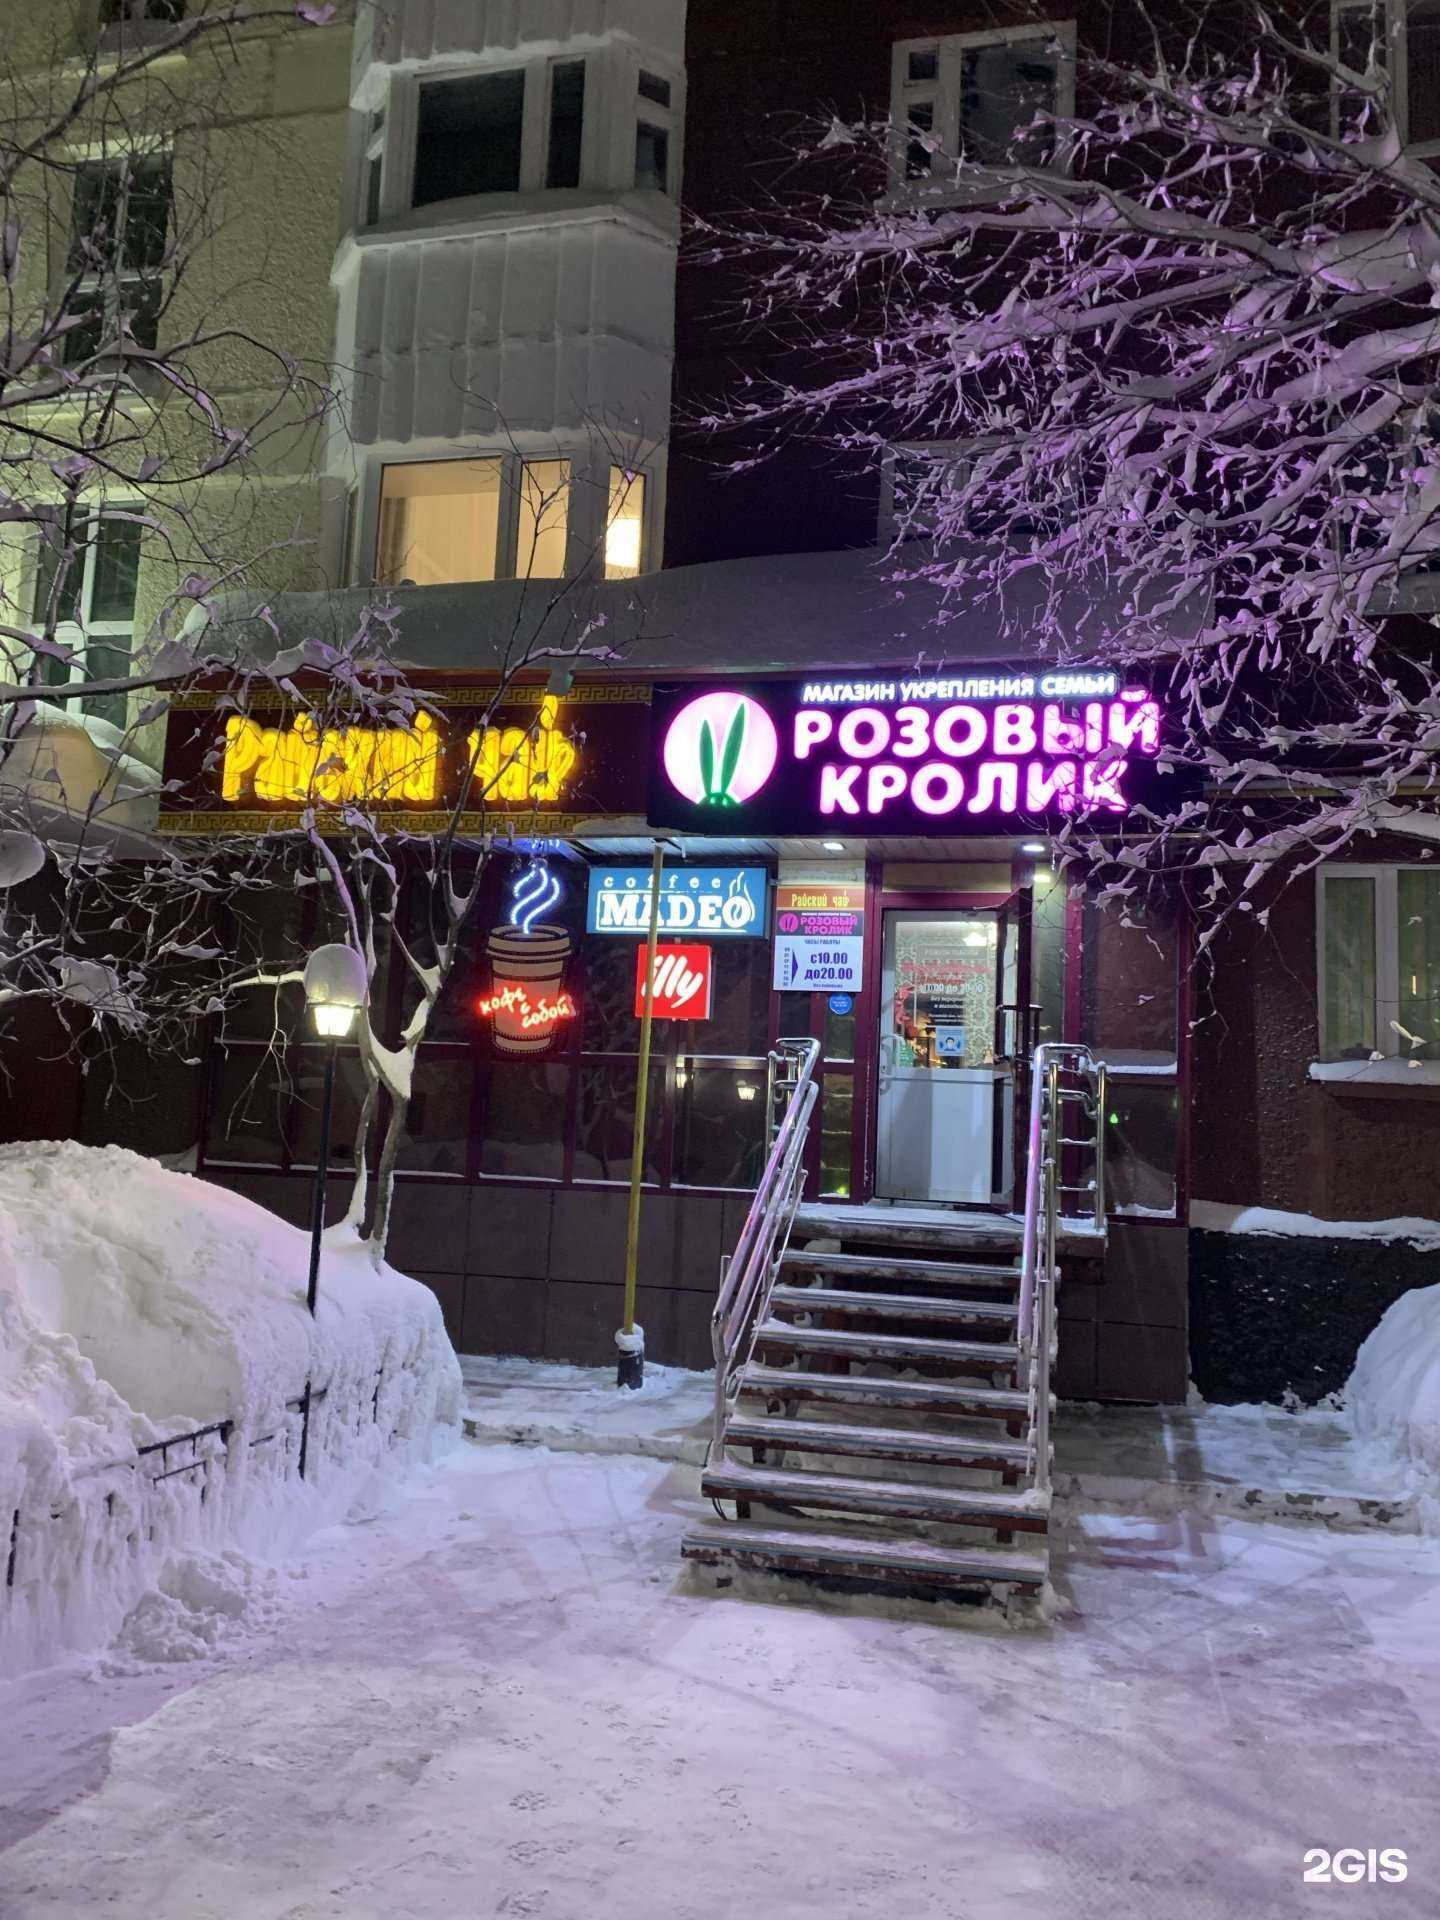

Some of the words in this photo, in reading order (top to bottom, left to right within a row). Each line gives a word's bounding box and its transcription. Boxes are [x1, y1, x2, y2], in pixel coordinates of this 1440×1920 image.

[802, 683, 895, 702] МАГАЗИН
[900, 677, 1035, 701] УКРЕПЛЕНИЯ
[1039, 674, 1116, 696] СЕМЬИ
[793, 688, 1161, 759] РОЗОВЫЙ
[818, 759, 1129, 815] КРОЛИК
[600, 893, 753, 929] MADEO
[800, 914, 858, 927] РОЗОВЫЙ
[804, 925, 854, 936] КРОЛИК
[480, 987, 527, 1015] кофе
[521, 995, 570, 1028] собой
